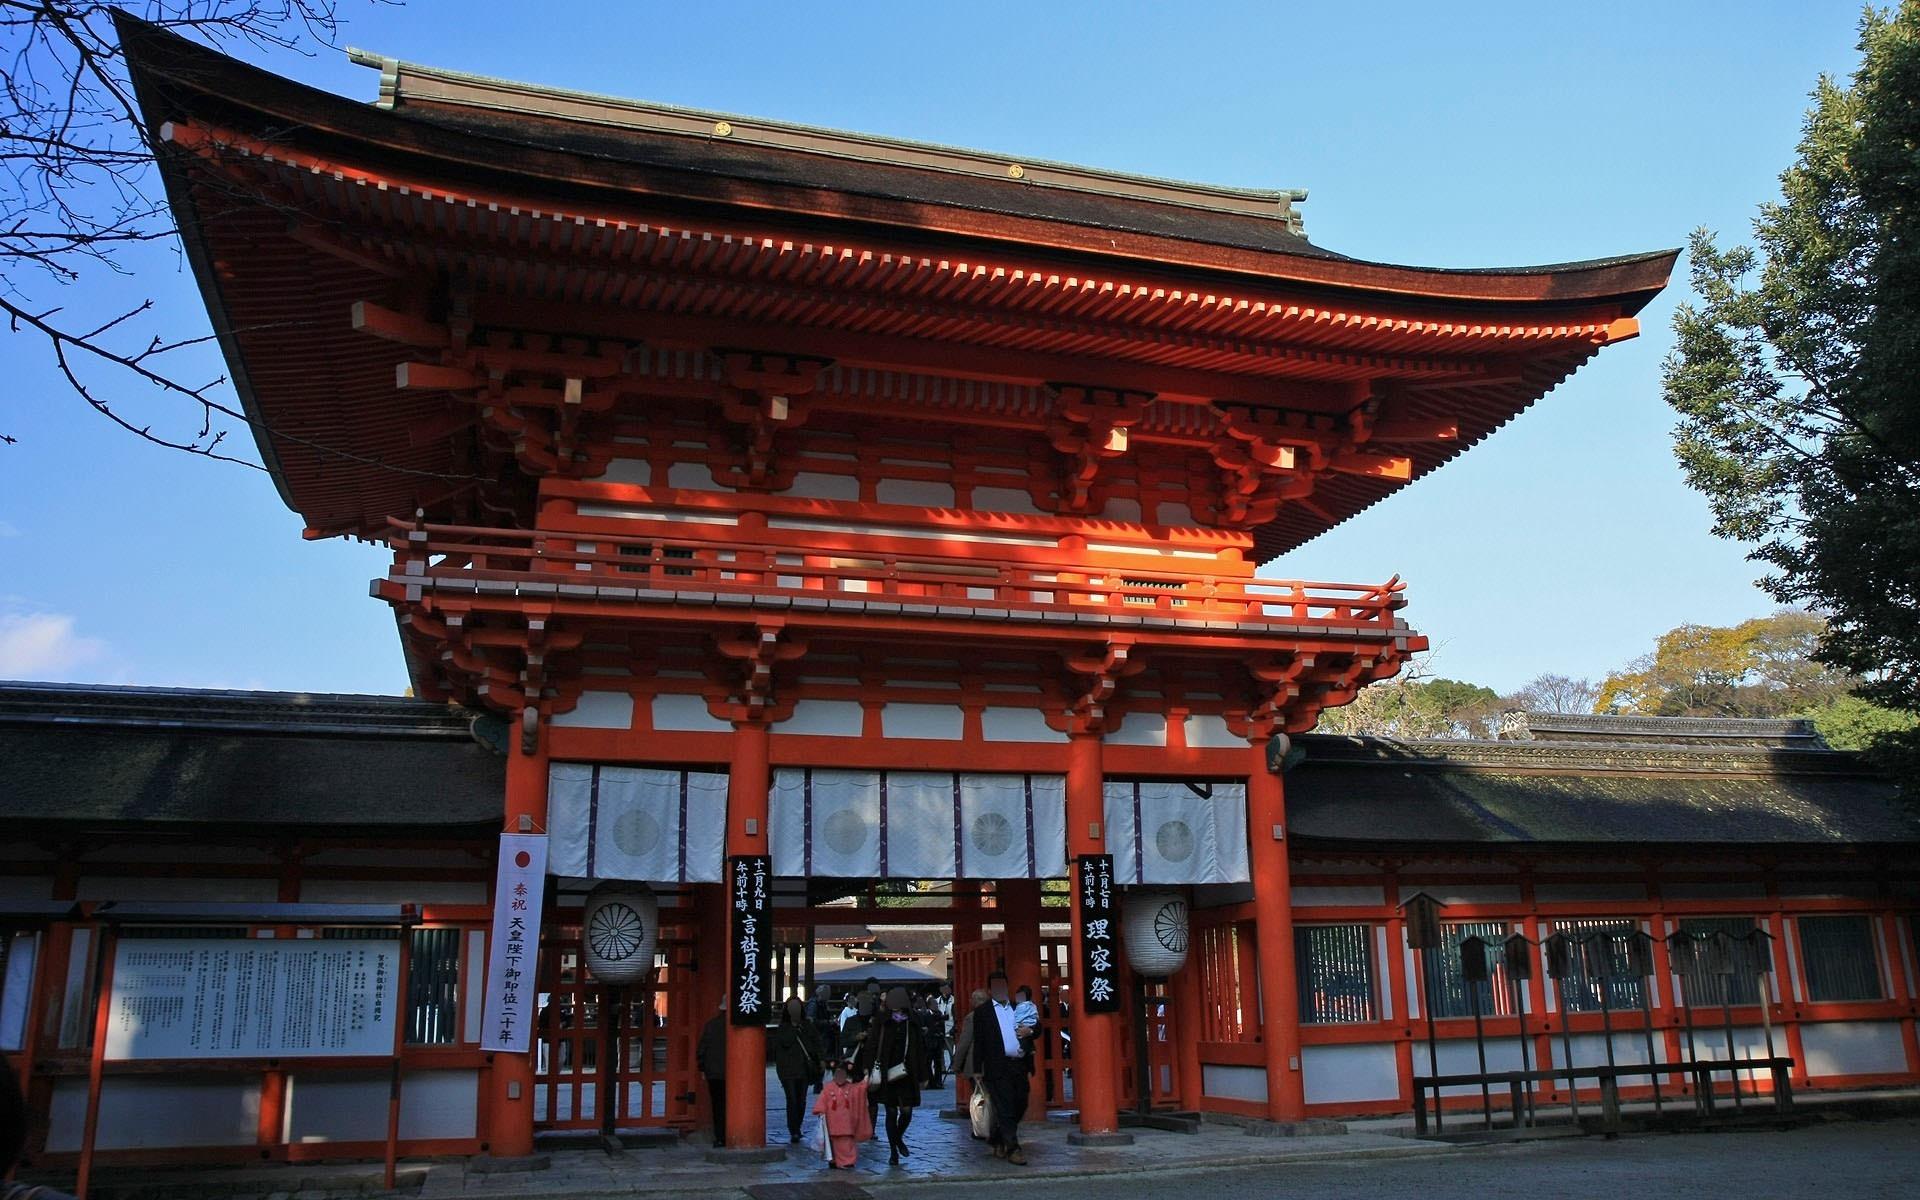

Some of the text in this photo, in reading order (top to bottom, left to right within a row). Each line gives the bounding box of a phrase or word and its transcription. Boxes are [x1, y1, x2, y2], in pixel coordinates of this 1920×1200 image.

[735, 861, 749, 912] 午前十時
[753, 859, 766, 910] 十二月九日
[1084, 861, 1096, 909] 午前十時
[1099, 859, 1111, 909] 十二月七日
[499, 882, 528, 1044] 奉祝 天皇陛下御即位二十年
[738, 914, 762, 1014] 言社月次祭
[1086, 918, 1114, 1002] 理容祭
